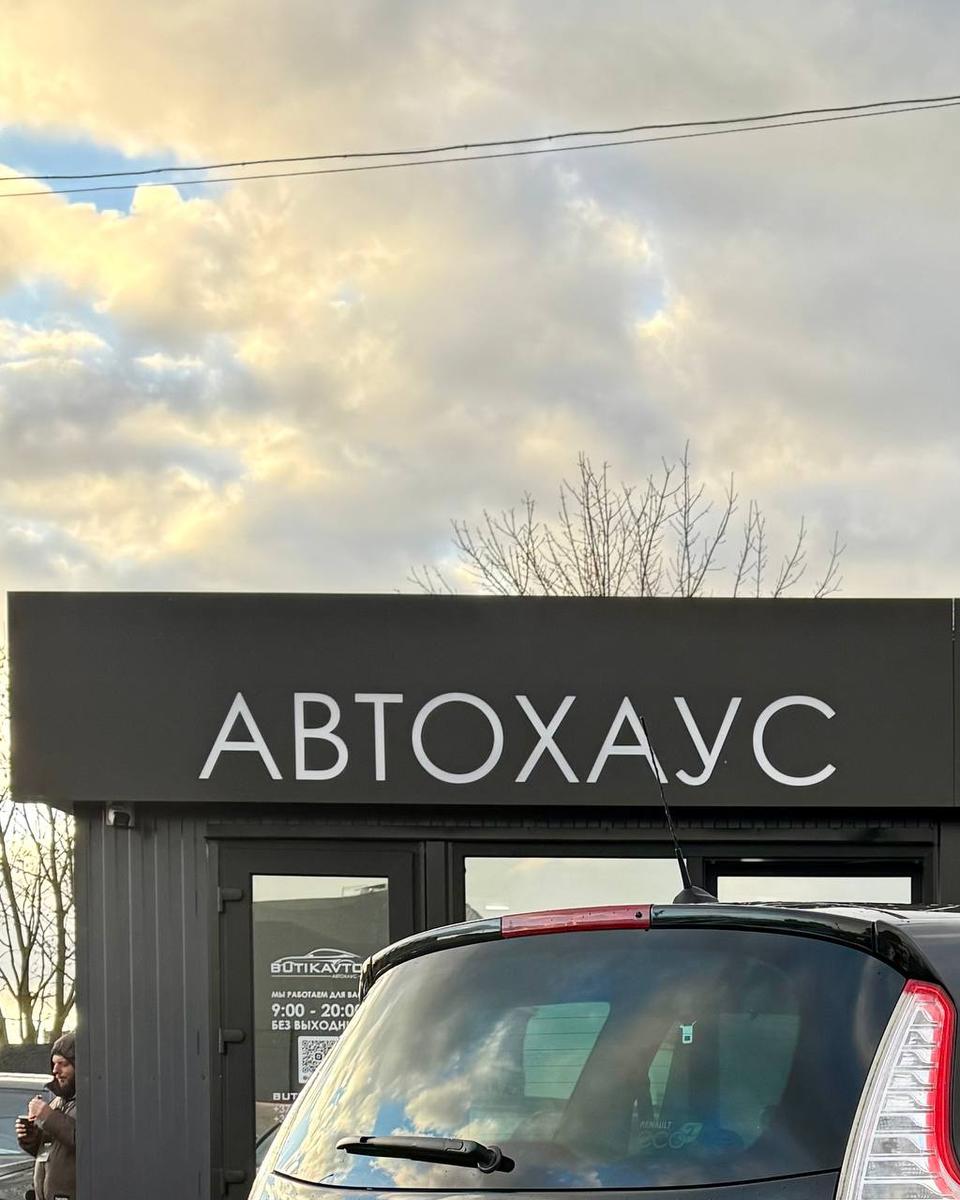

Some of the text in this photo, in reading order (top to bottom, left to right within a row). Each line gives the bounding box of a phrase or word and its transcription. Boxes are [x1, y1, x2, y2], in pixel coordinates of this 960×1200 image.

[198, 692, 837, 786] АВТОХАУС
[329, 991, 345, 999] ДЛЯ
[271, 1003, 304, 1018] 9:00
[271, 1020, 291, 1030] БЕЗ
